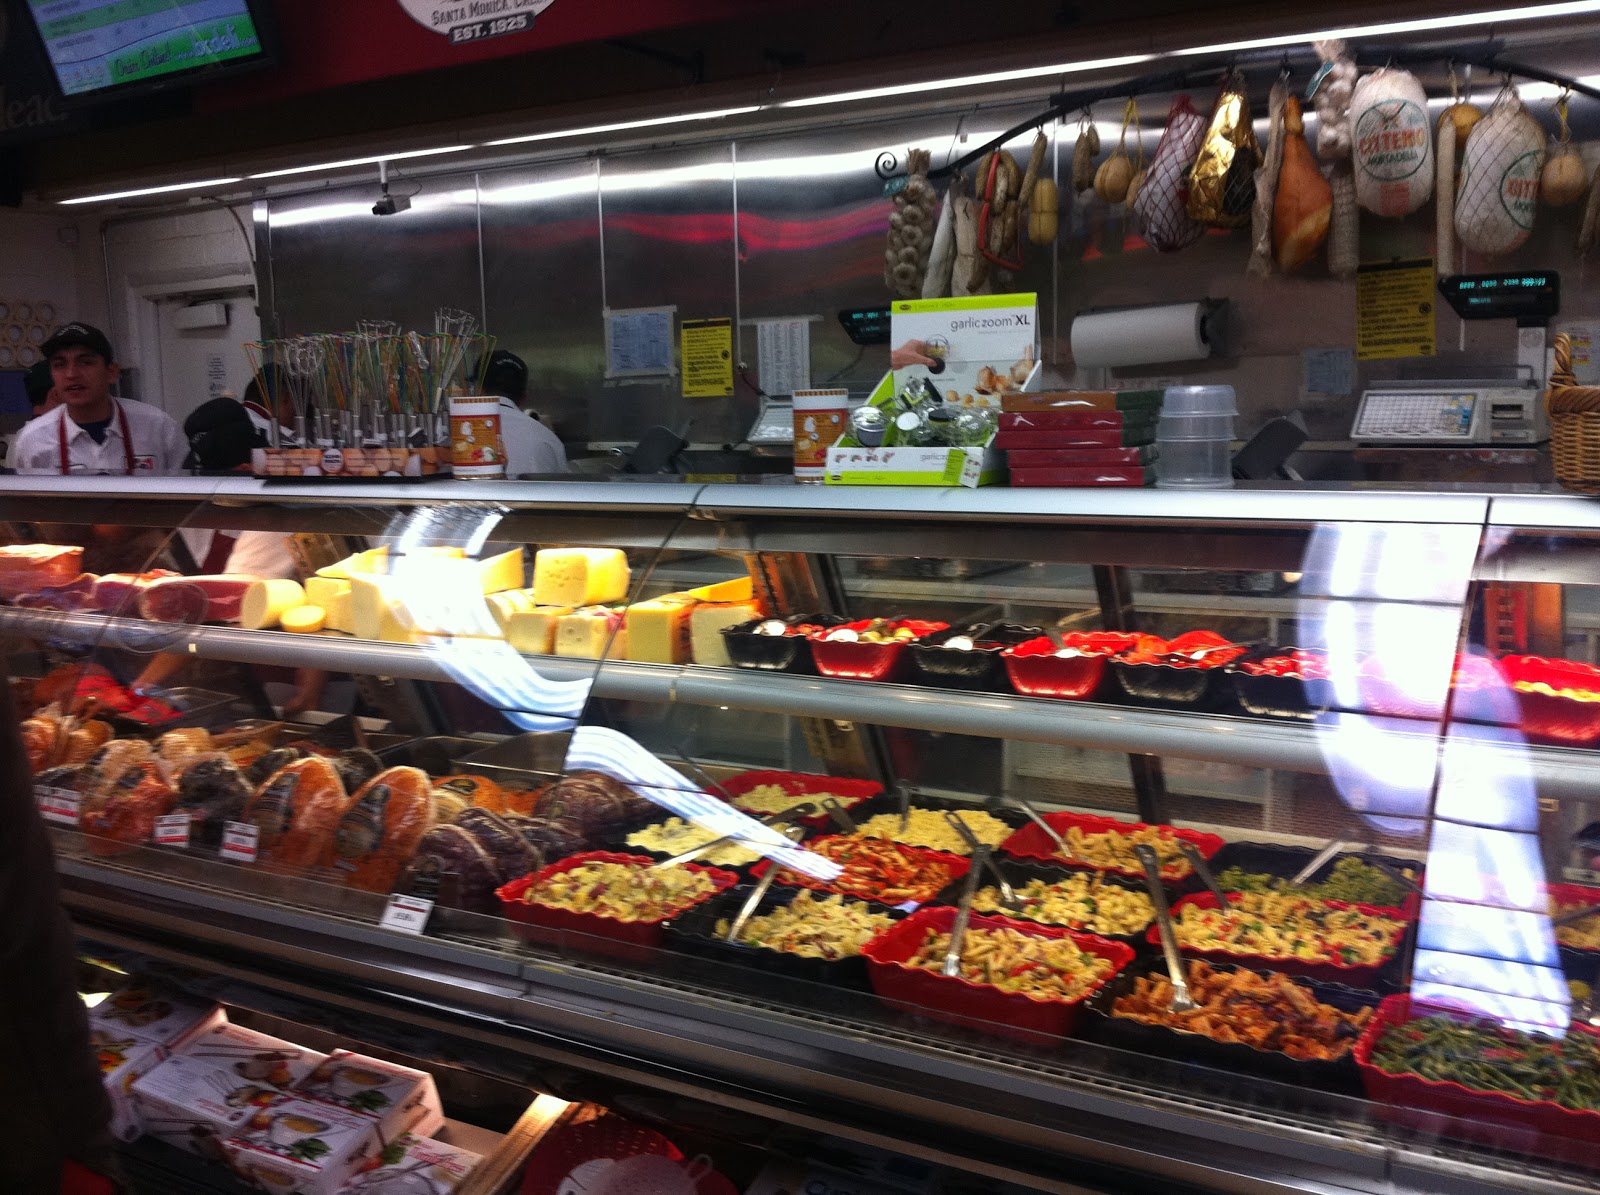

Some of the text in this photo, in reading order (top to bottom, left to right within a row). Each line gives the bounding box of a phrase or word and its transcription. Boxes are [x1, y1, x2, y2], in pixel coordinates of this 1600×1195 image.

[431, 9, 466, 26] SANTA
[453, 23, 487, 42] EST.
[1015, 314, 1030, 325] XL
